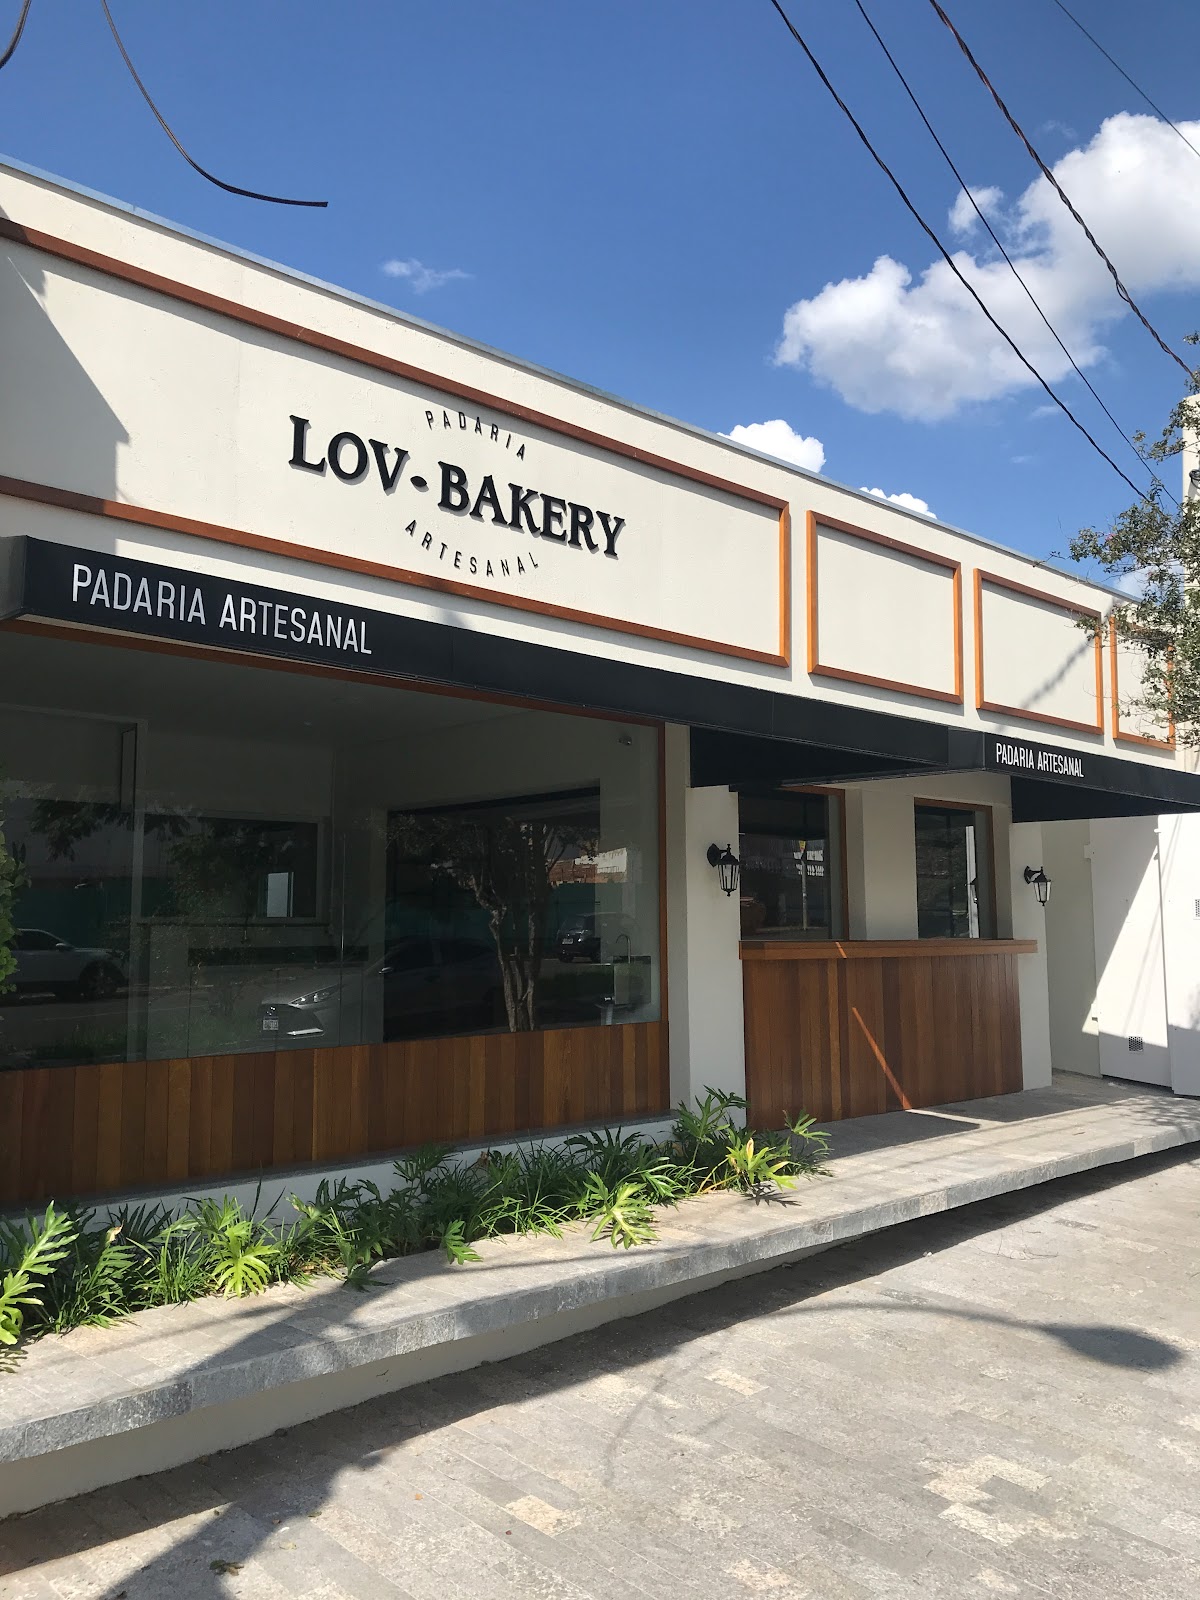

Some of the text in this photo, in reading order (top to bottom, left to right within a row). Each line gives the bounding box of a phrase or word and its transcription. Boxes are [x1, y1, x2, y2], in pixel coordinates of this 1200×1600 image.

[425, 410, 526, 460] PADARIA
[289, 414, 626, 558] LOV BAKERY
[404, 519, 539, 578] ARTESANAL
[72, 563, 372, 655] PADARIA ARTESANAL
[996, 742, 1085, 778] PADARIA ARTESANAL
